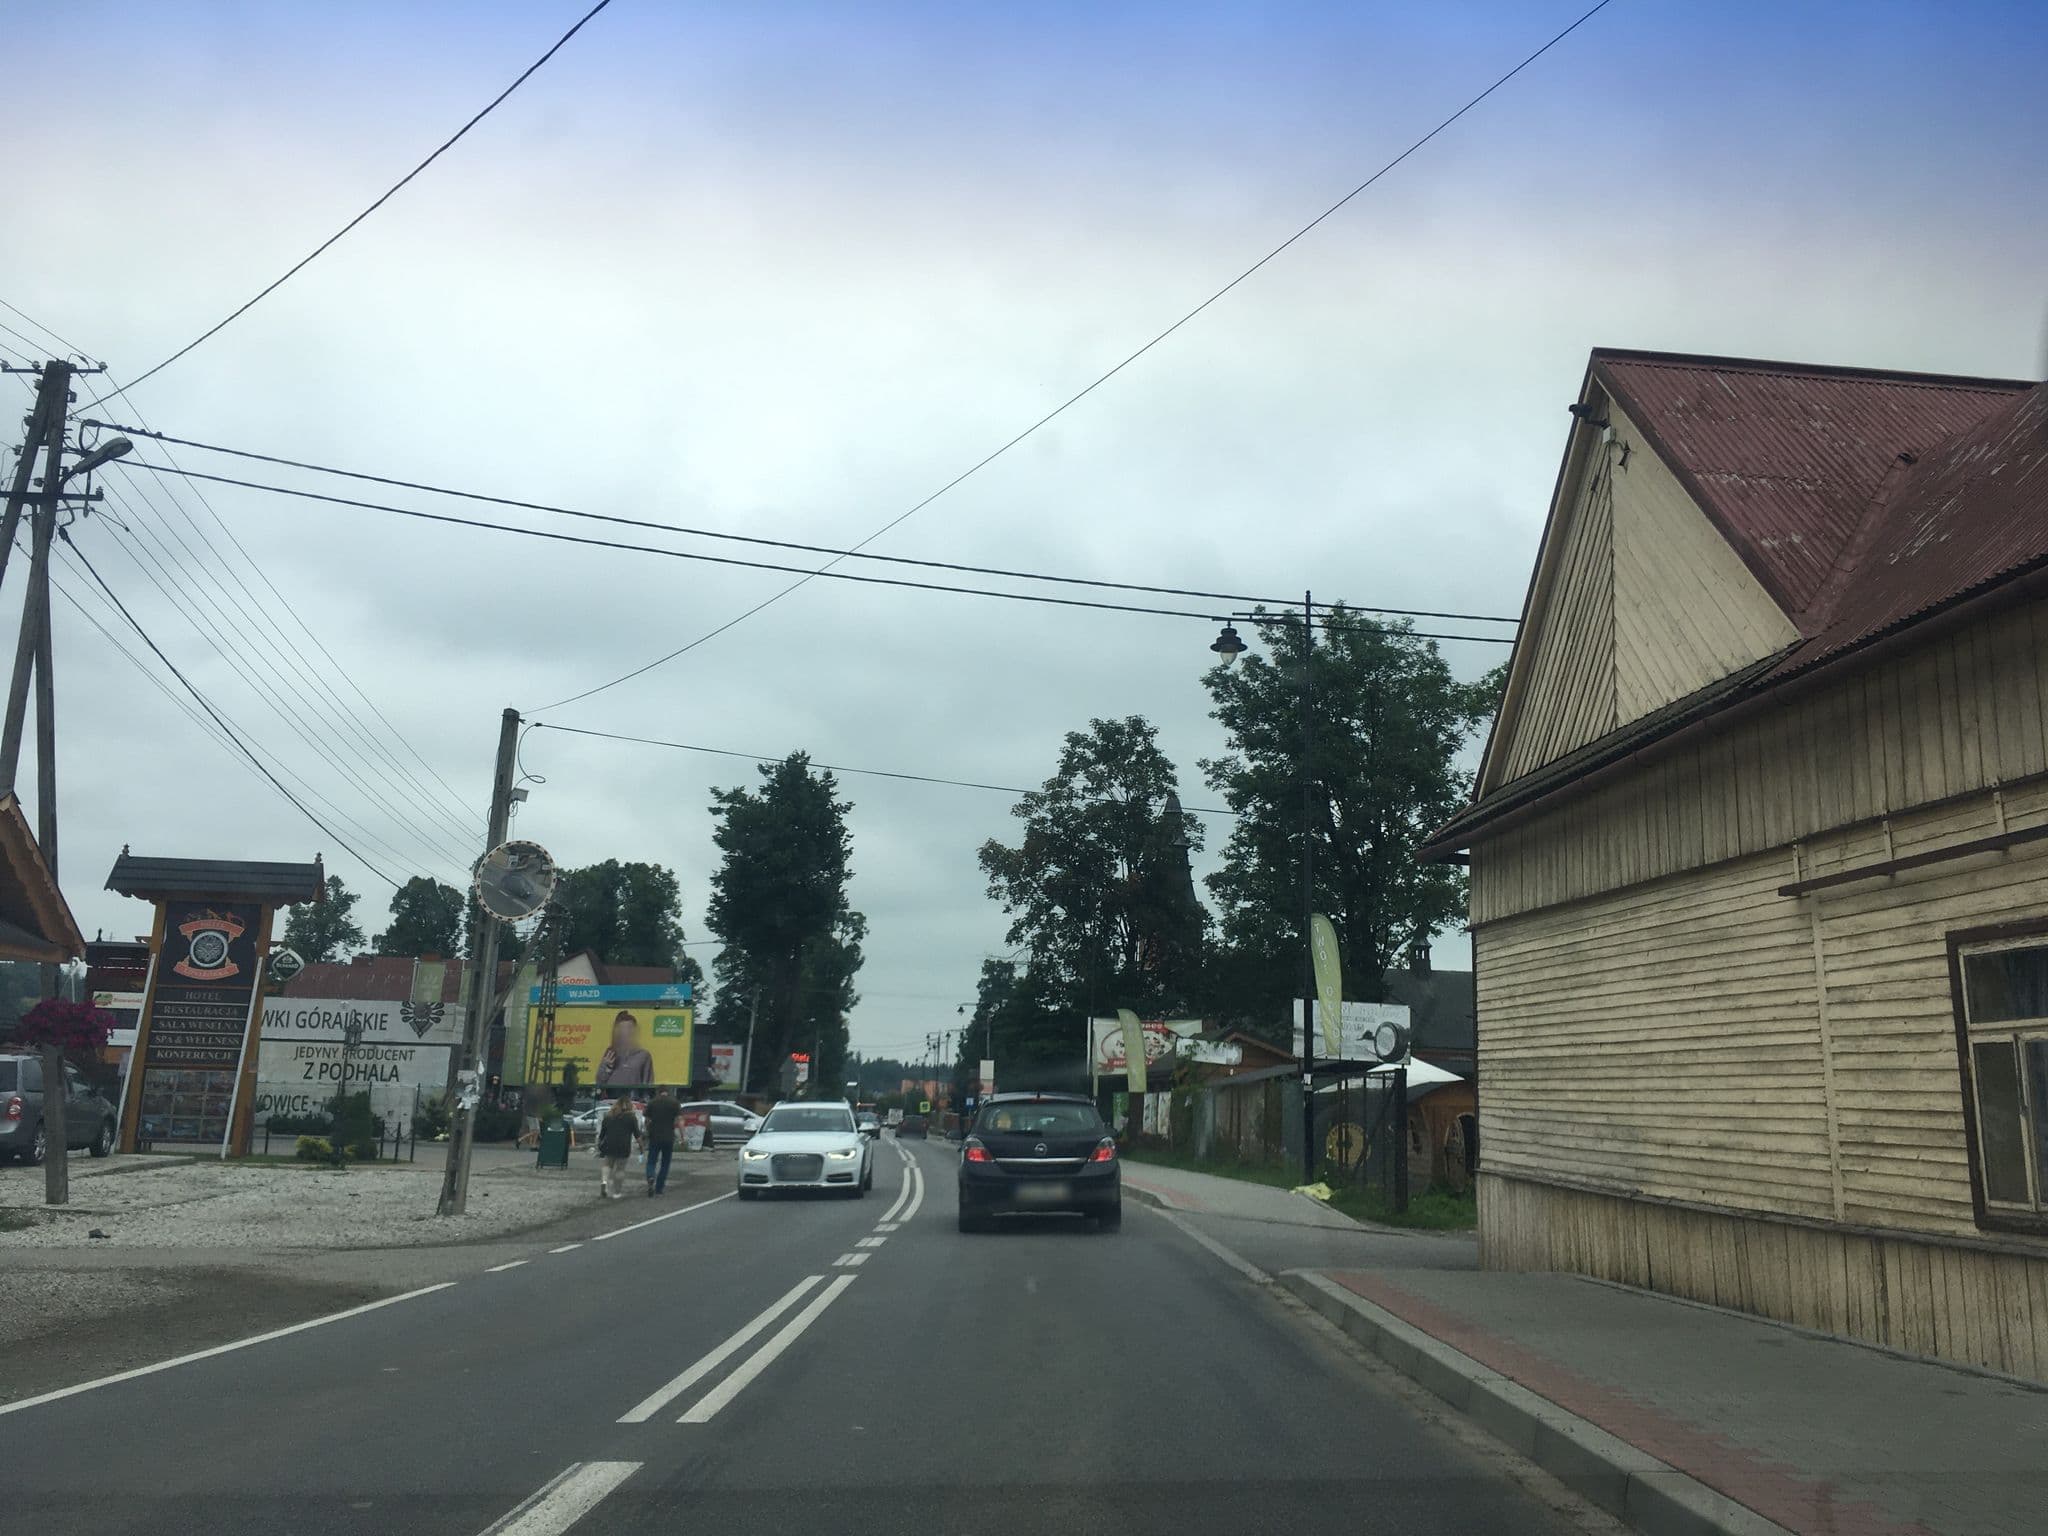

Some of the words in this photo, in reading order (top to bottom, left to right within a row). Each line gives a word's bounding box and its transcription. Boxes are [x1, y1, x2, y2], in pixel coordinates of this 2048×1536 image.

[185, 991, 222, 1001] HOTEL
[568, 990, 600, 998] WJAZD
[163, 1006, 239, 1016] RESTAURACJA
[295, 1006, 389, 1031] GÓRALSKIE
[158, 1020, 186, 1030] SALA
[188, 1021, 239, 1031] WESELNA
[154, 1035, 172, 1044] SPA
[175, 1036, 184, 1045] &
[185, 1036, 241, 1046] WELLNESS
[156, 1051, 233, 1060] KONFERENCJE
[293, 1046, 340, 1061] JEDYNY
[342, 1047, 416, 1062] PRODUCENT
[303, 1062, 315, 1080] Z
[318, 1063, 400, 1082] PODHALA
